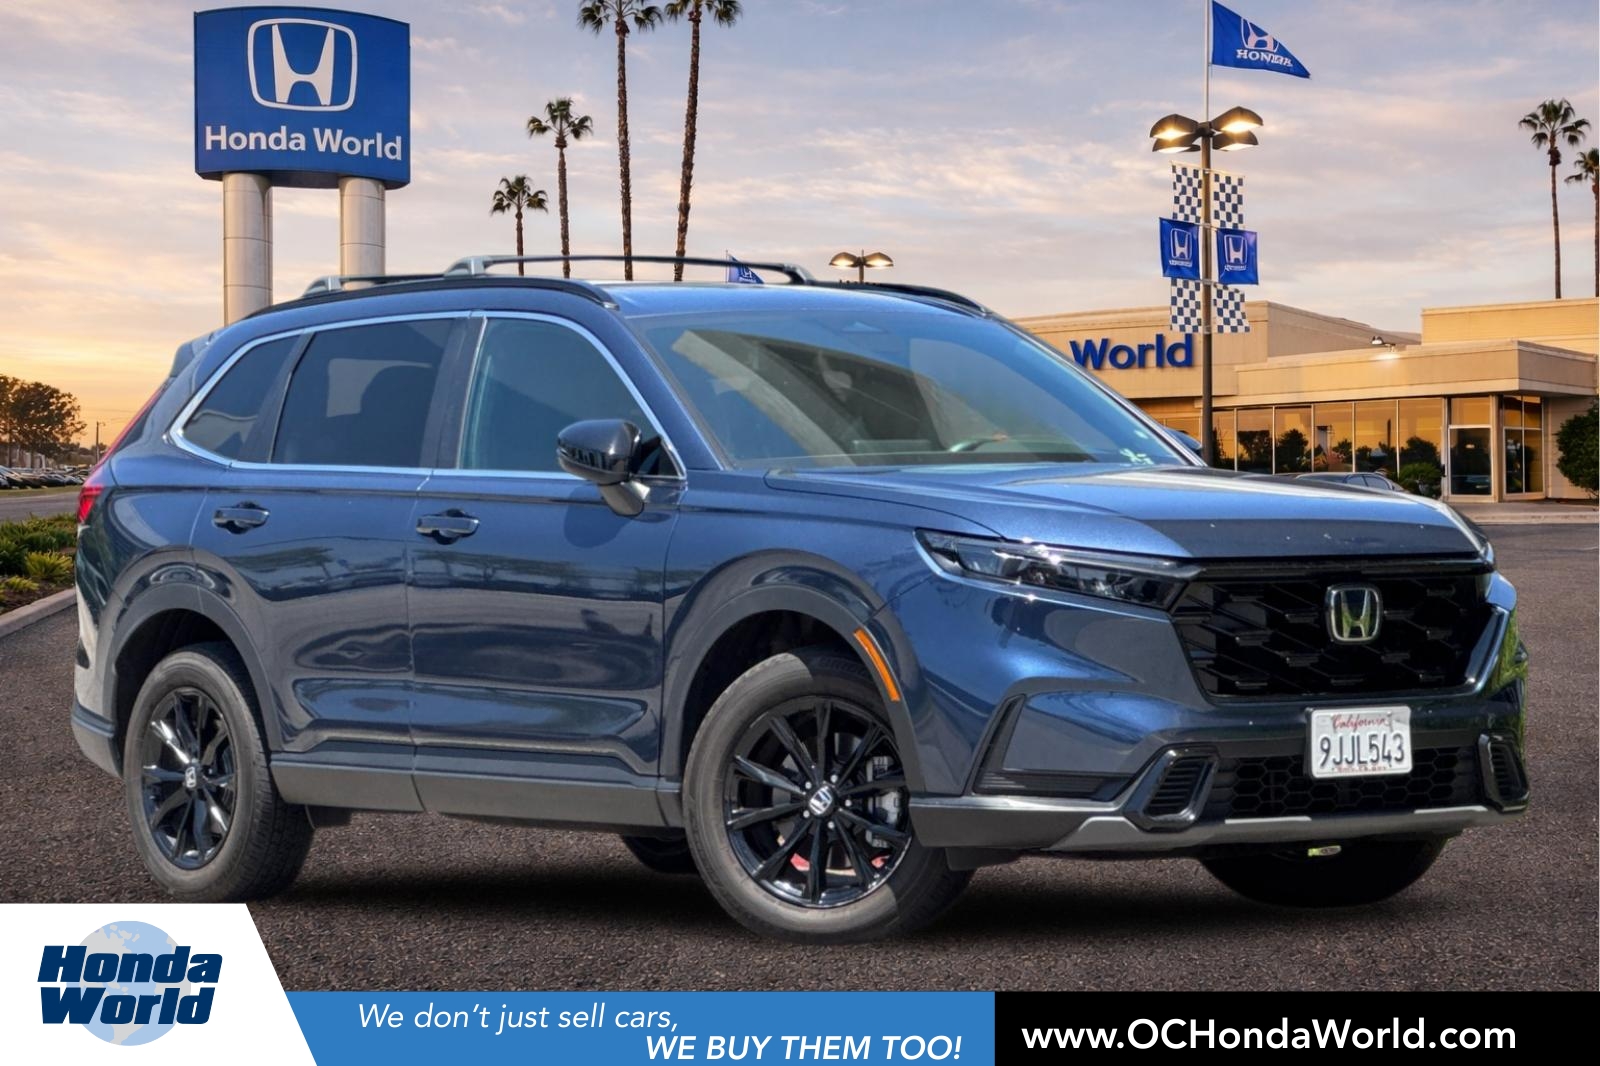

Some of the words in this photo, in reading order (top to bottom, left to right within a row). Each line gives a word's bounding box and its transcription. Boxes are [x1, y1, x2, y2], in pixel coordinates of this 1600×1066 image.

[205, 125, 306, 151] Honda
[313, 127, 402, 160] World
[1069, 333, 1192, 370] World
[1332, 714, 1386, 731] California
[1320, 733, 1405, 767] 9JJL543
